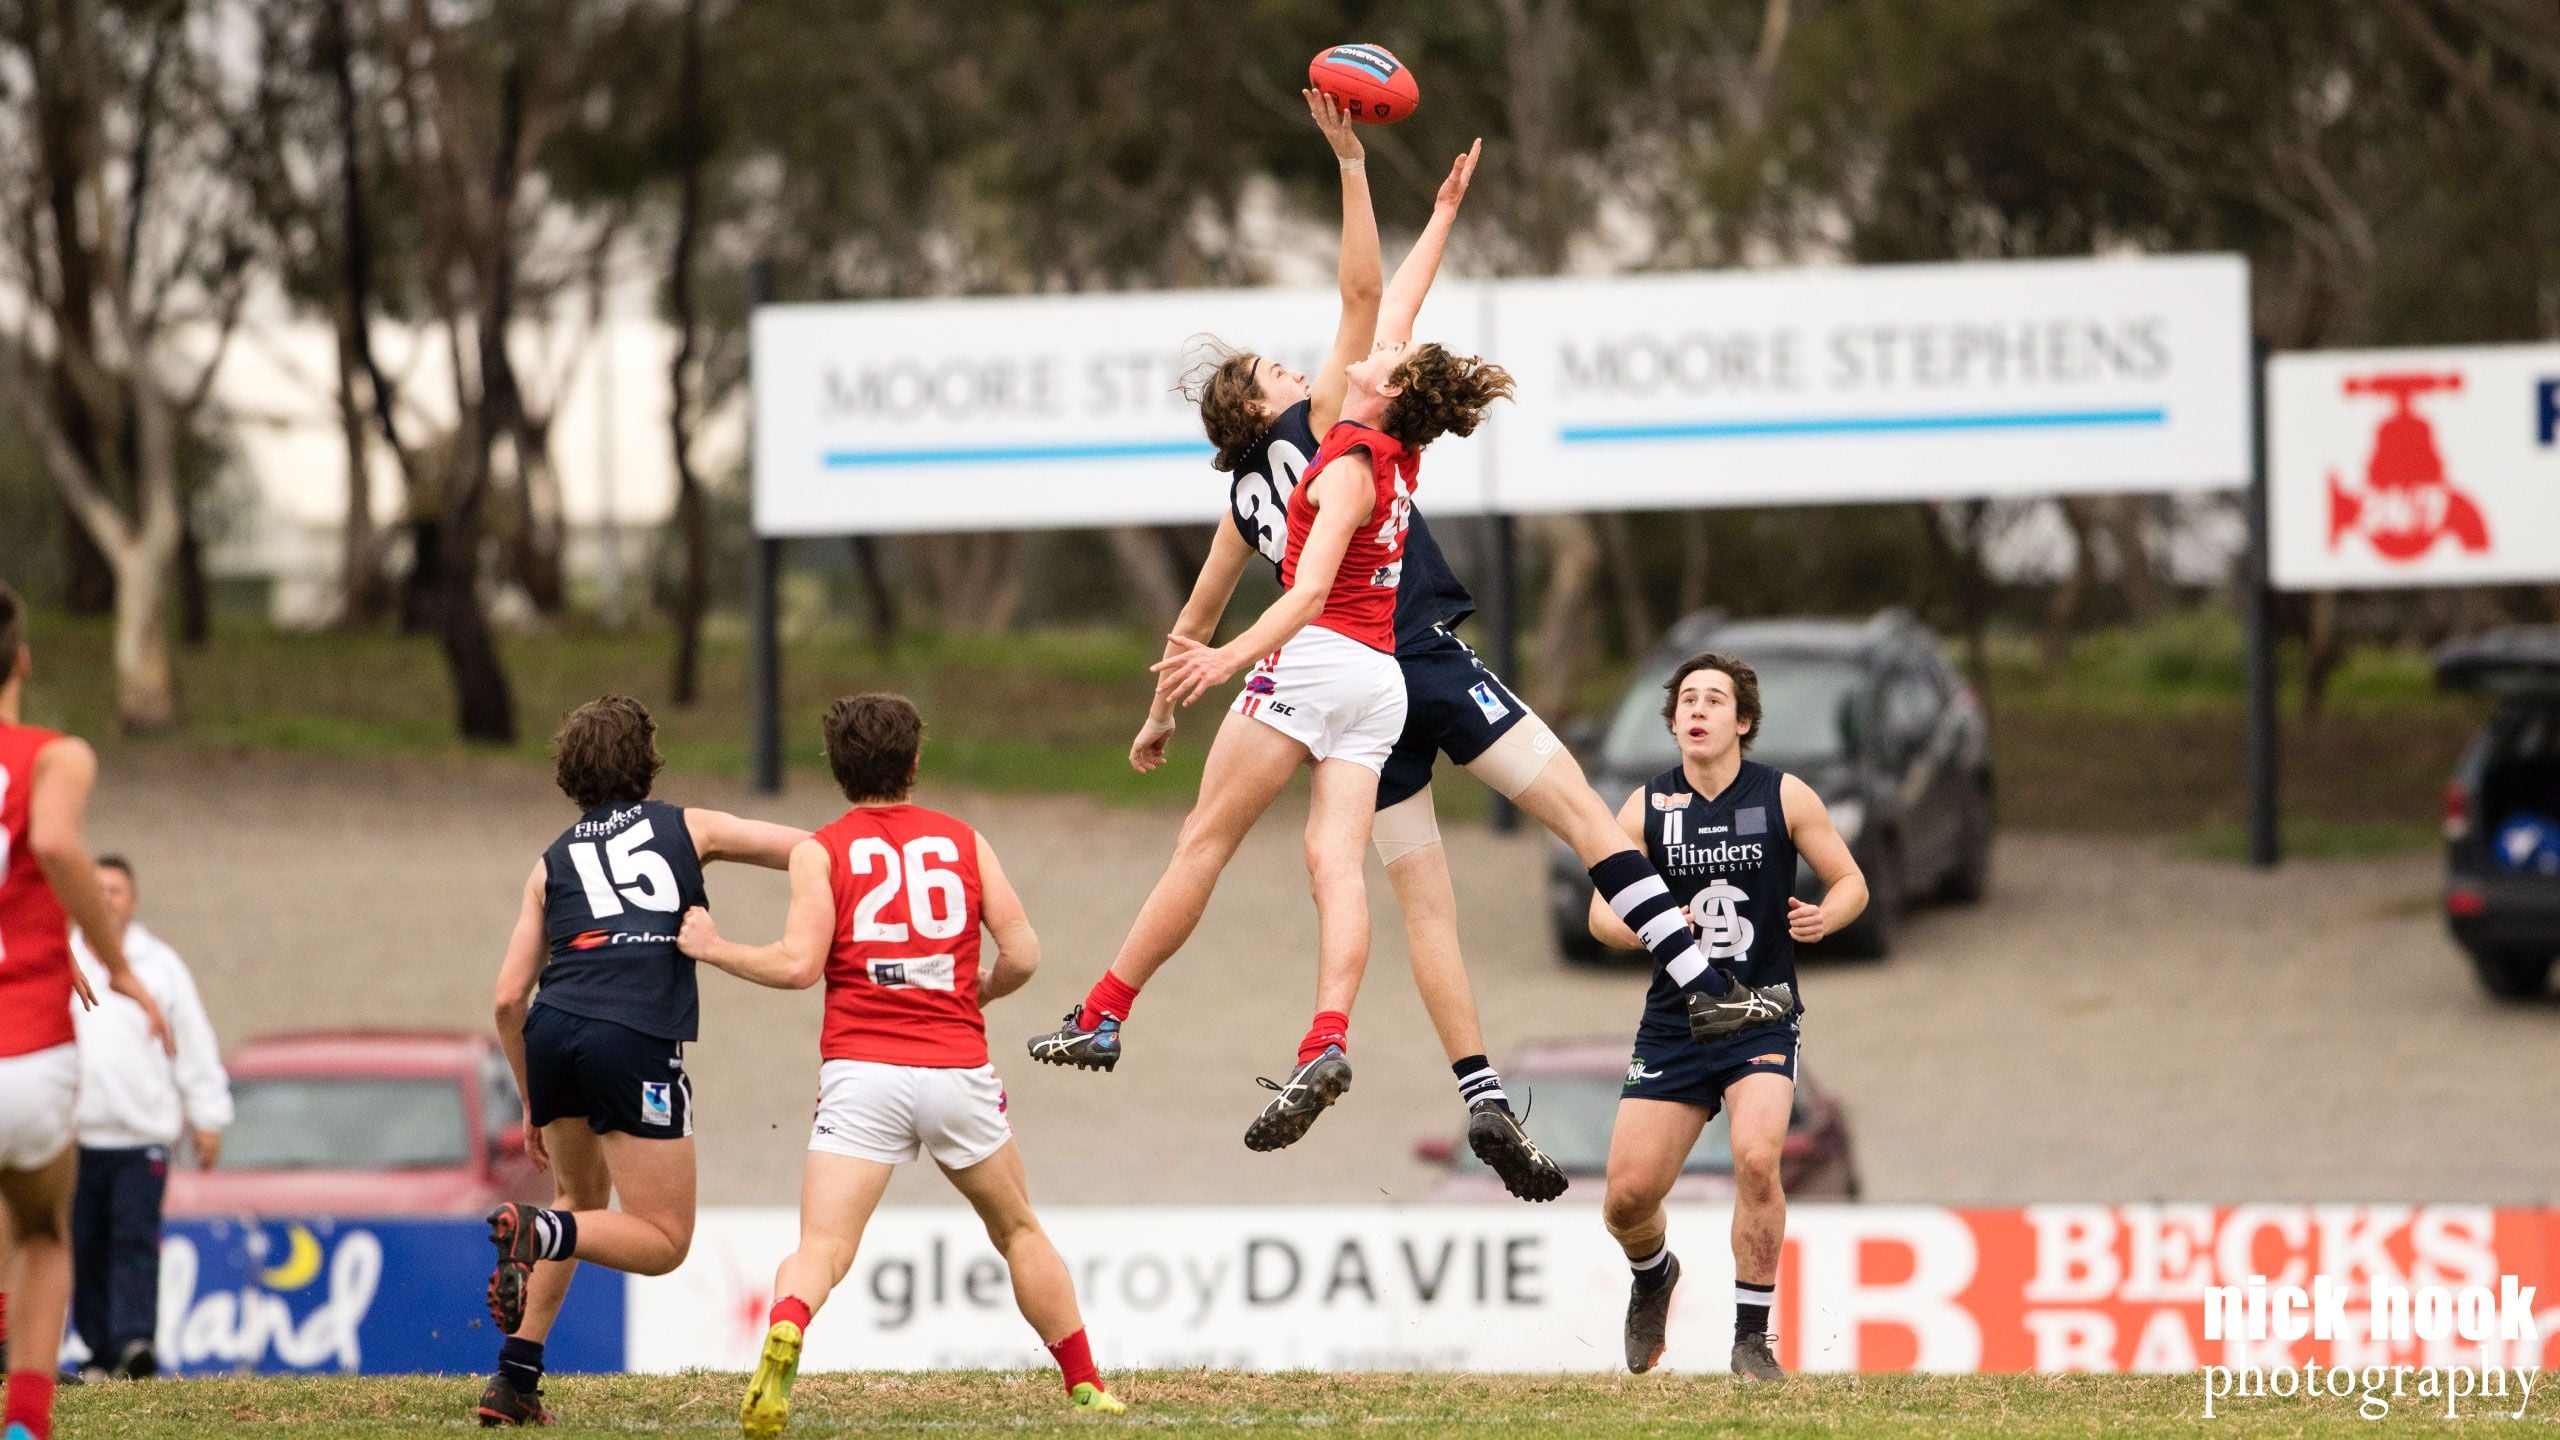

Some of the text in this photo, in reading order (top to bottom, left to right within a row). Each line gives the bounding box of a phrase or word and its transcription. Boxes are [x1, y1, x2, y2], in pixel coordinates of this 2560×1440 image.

[821, 351, 1069, 426] MOORE
[1556, 312, 2172, 397] MOORE STEPHENS
[1236, 439, 1310, 564] 30
[1269, 700, 1296, 717] ISC
[574, 804, 642, 834] Flinders
[1662, 810, 1683, 845] 11
[1666, 840, 1763, 867] Flinders
[1698, 825, 1729, 835] NELSON
[568, 818, 681, 919] 15
[849, 836, 967, 943] 26
[1668, 861, 1763, 877] UNIVERSITY
[611, 931, 678, 945] Colon
[868, 1233, 1546, 1331] gleroyDAVIE
[2022, 1203, 2500, 1303] BECKS
[157, 1232, 383, 1372] land
